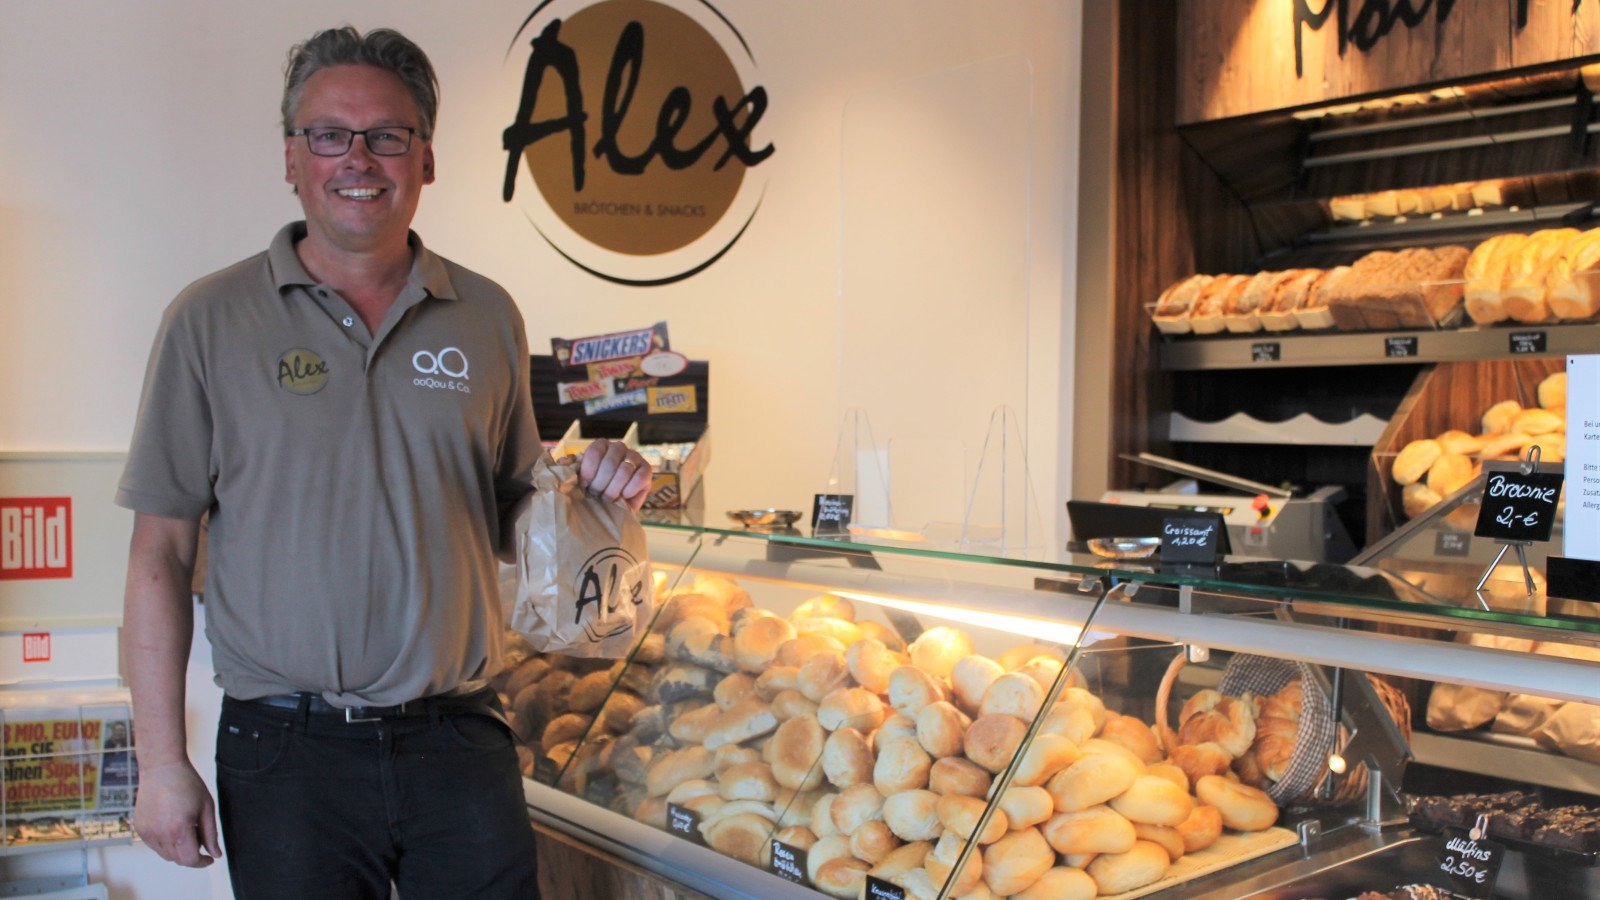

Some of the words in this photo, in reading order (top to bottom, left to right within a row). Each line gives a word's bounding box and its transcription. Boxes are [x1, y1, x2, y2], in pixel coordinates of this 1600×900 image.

[502, 18, 776, 202] Alex
[573, 200, 641, 216] BRÖTCHEN
[644, 203, 654, 216] &
[656, 204, 706, 217] SNACKS
[575, 333, 649, 362] SNICKERS
[276, 355, 330, 388] Alex
[447, 381, 455, 390] &
[1583, 420, 1594, 428] Bei
[1583, 463, 1598, 471] Bitte
[1489, 475, 1556, 504] Brownie
[1, 506, 67, 570] Bild
[1165, 524, 1213, 537] Croissant
[574, 563, 643, 625] Ale
[25, 635, 49, 660] Bild
[15, 722, 48, 743] MIO.
[1446, 837, 1491, 860] Muffins
